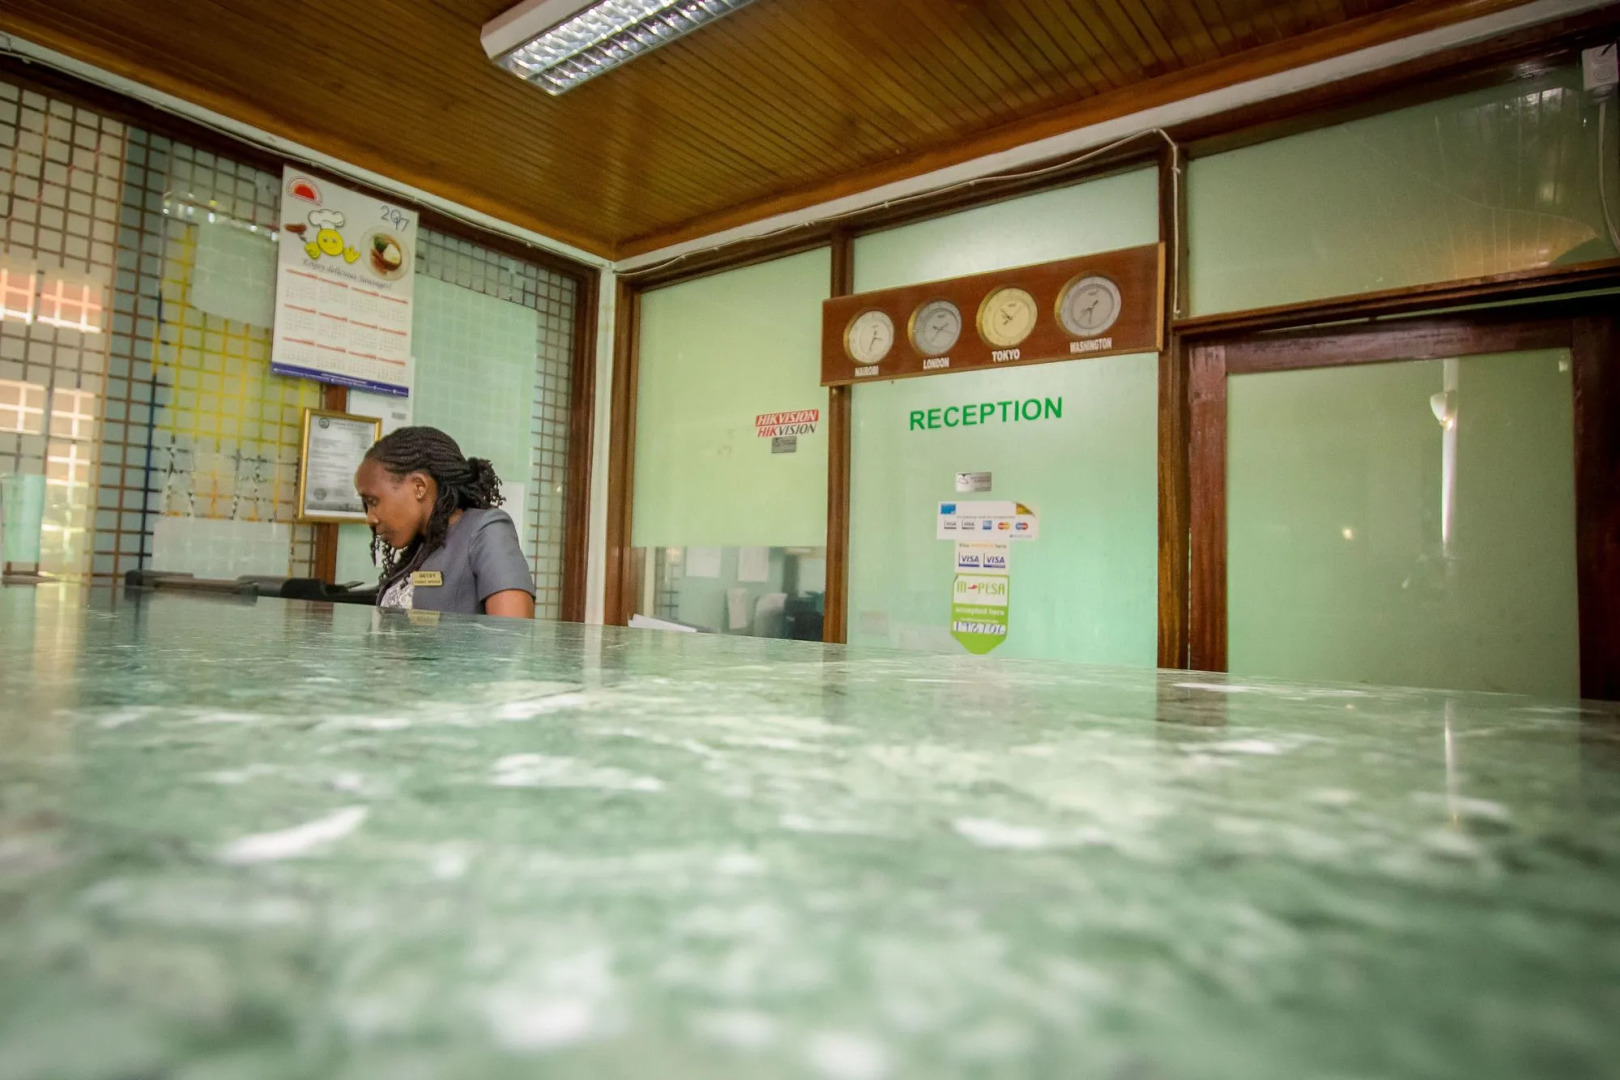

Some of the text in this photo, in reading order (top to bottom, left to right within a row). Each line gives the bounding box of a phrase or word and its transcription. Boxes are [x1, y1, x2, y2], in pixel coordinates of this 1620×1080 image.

[1070, 338, 1112, 353] WASHINGTON
[992, 349, 1020, 362] TOKYO
[923, 357, 950, 370] LONDON
[854, 365, 879, 377] NAIROBI
[757, 410, 817, 426] HIKVISION
[909, 396, 1063, 431] RECEPTION
[757, 423, 817, 437] HIKVISION
